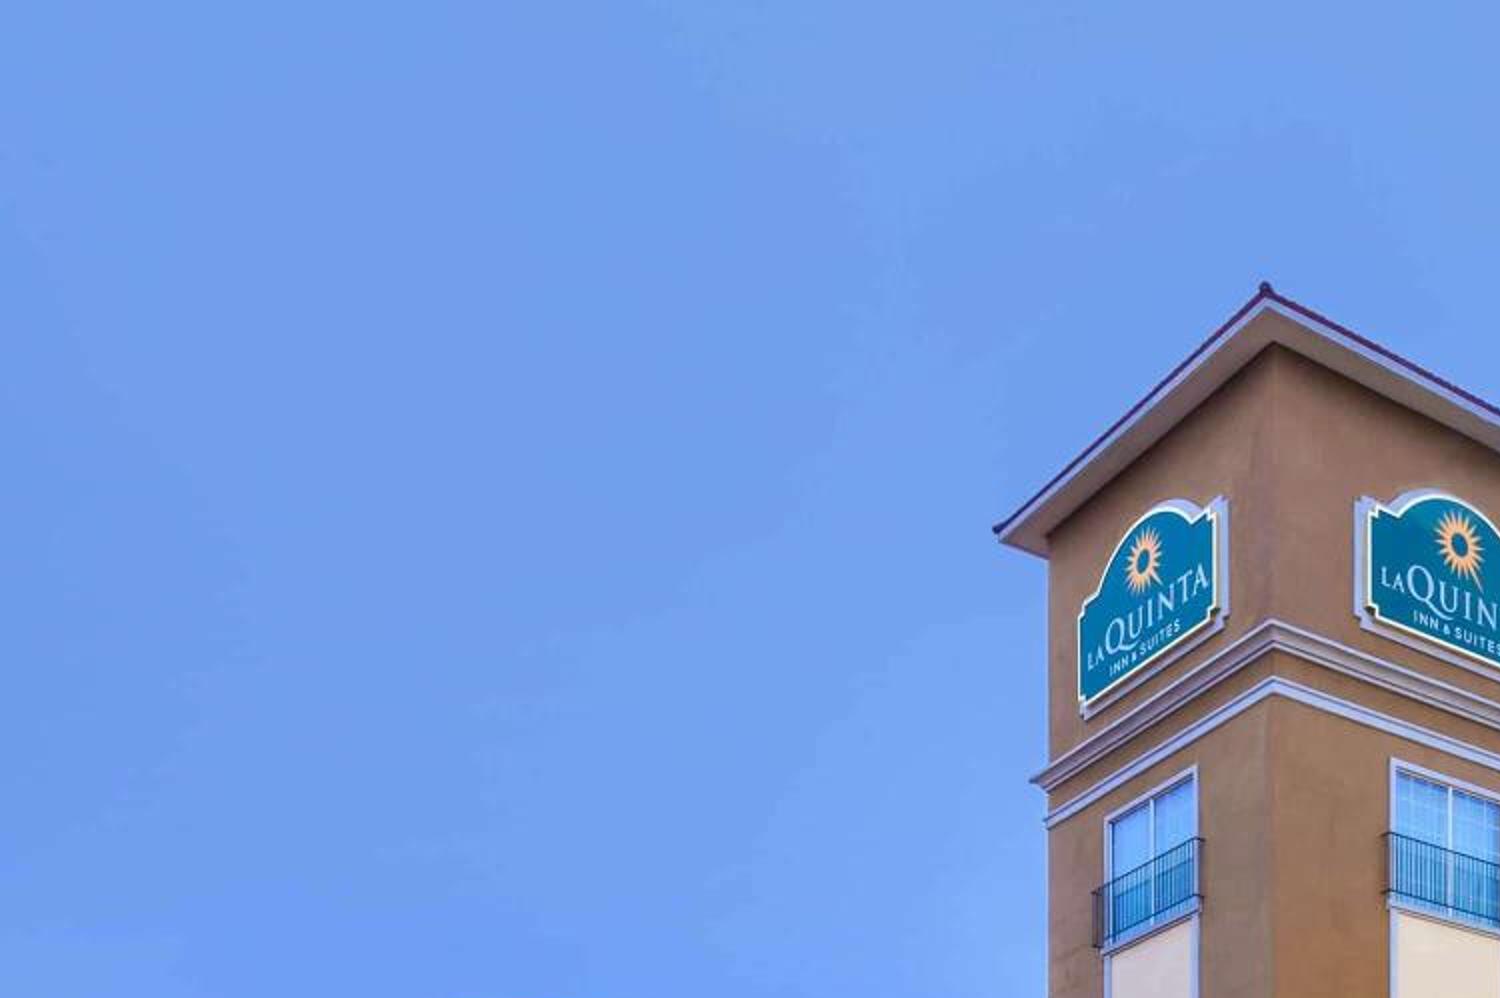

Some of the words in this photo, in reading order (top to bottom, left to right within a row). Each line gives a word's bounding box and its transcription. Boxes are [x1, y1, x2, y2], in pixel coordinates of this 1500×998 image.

[1381, 566, 1405, 594] LA
[1087, 646, 1105, 670] LA
[1105, 563, 1209, 656] QUINTA
[1413, 610, 1439, 631] INN
[1109, 654, 1129, 677] INN
[1139, 618, 1181, 657] SUITES
